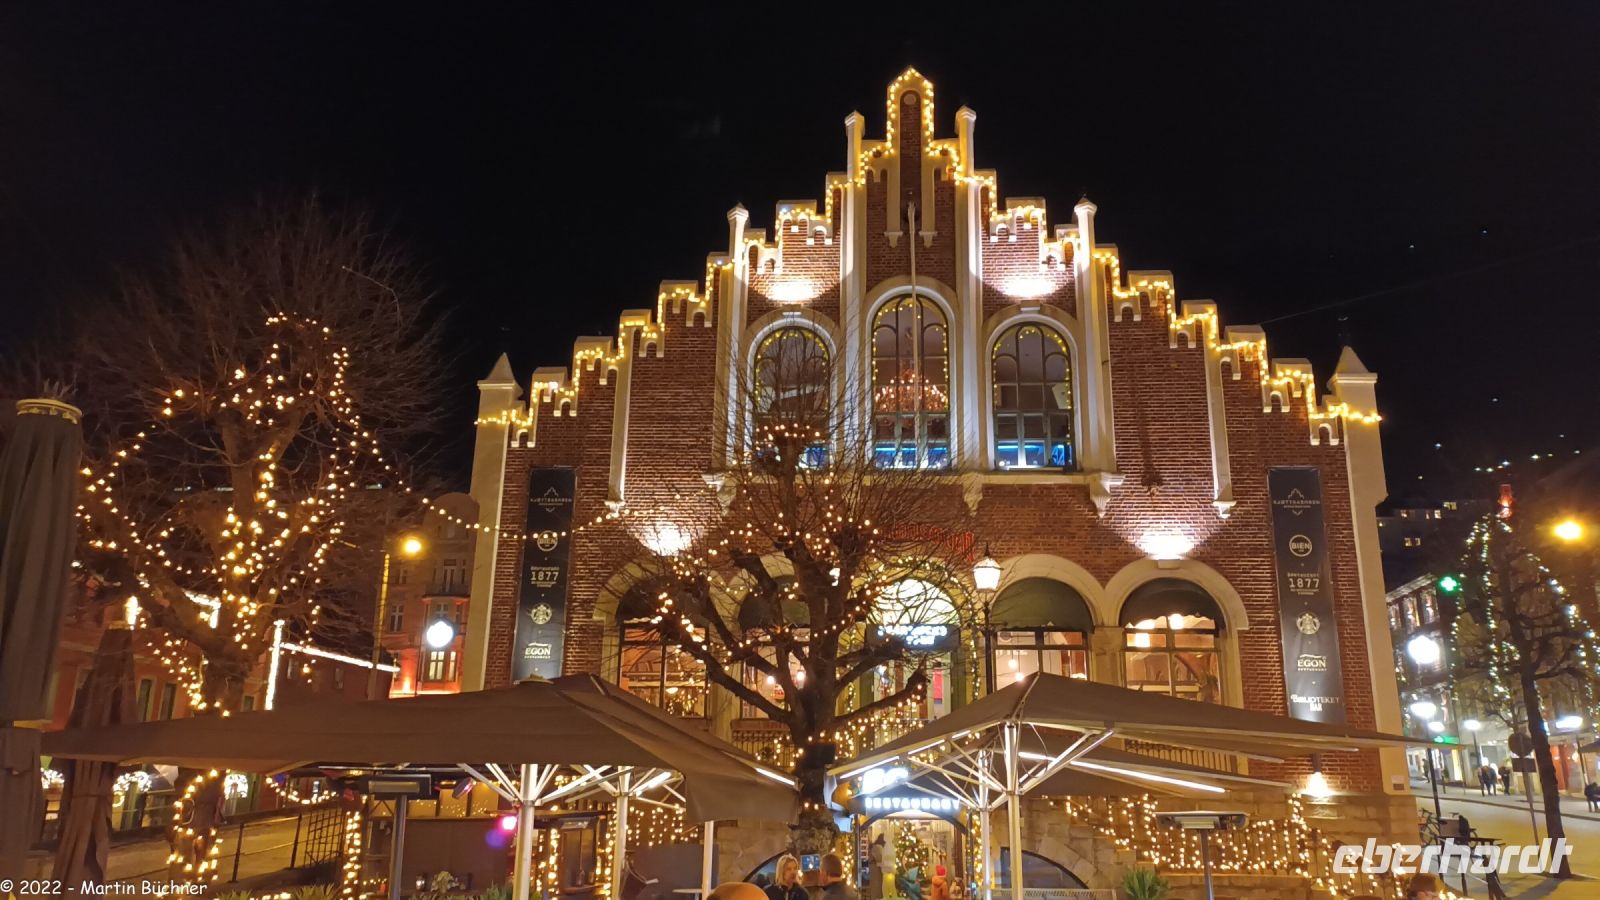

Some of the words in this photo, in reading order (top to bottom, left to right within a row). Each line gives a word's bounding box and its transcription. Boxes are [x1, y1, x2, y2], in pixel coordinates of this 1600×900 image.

[1291, 542, 1310, 550] BIEN
[530, 571, 559, 581] 1877
[1289, 578, 1319, 588] 1877
[525, 647, 551, 656] EGON
[1297, 659, 1326, 667] EGON
